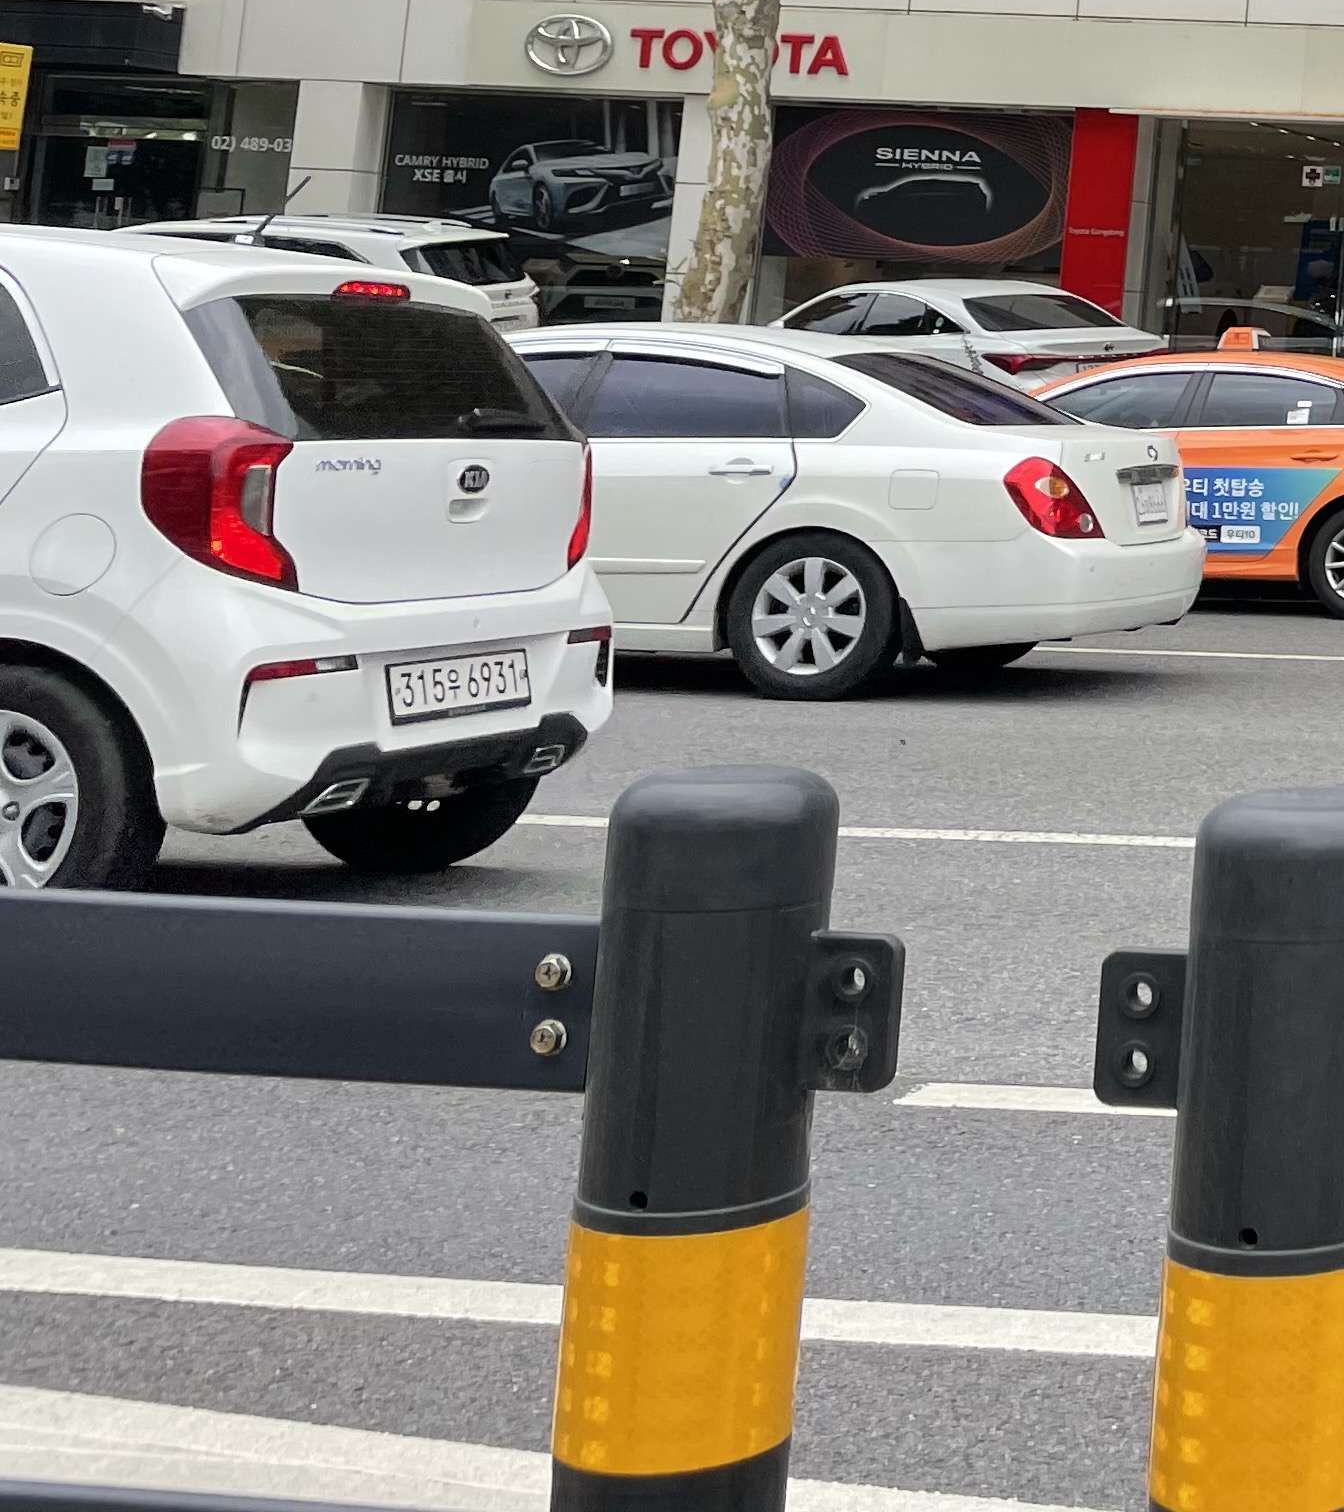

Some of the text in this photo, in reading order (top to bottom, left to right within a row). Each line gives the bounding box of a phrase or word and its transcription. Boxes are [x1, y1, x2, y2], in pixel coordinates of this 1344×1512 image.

[629, 28, 849, 76] TOTA
[211, 136, 236, 153] 02)
[394, 153, 489, 170] CAMRY HYBRID
[875, 147, 982, 163] SIENNA
[412, 168, 440, 182] XSE
[315, 457, 382, 476] morning
[464, 470, 489, 489] KIA
[1213, 478, 1265, 498] 첫탑승
[1212, 501, 1256, 521] 1만원
